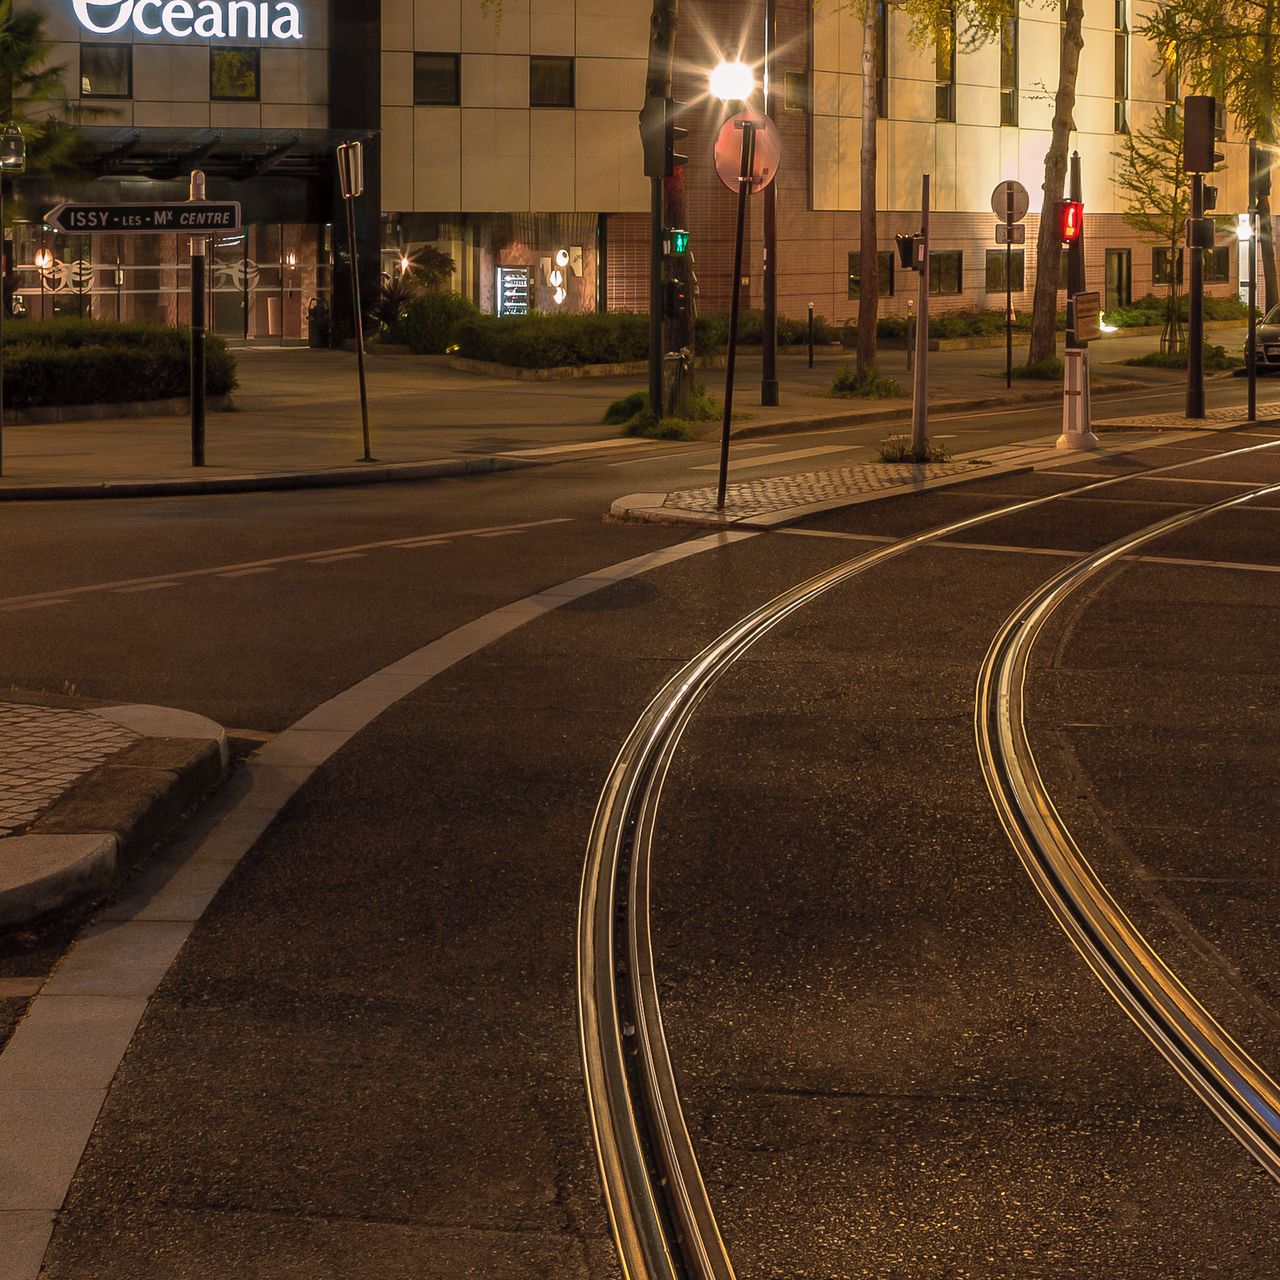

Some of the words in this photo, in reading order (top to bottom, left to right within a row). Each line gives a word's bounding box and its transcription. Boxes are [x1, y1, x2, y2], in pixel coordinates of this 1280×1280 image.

[70, 211, 109, 227] ISSY
[122, 215, 142, 226] LES
[179, 211, 231, 225] CENTRE
